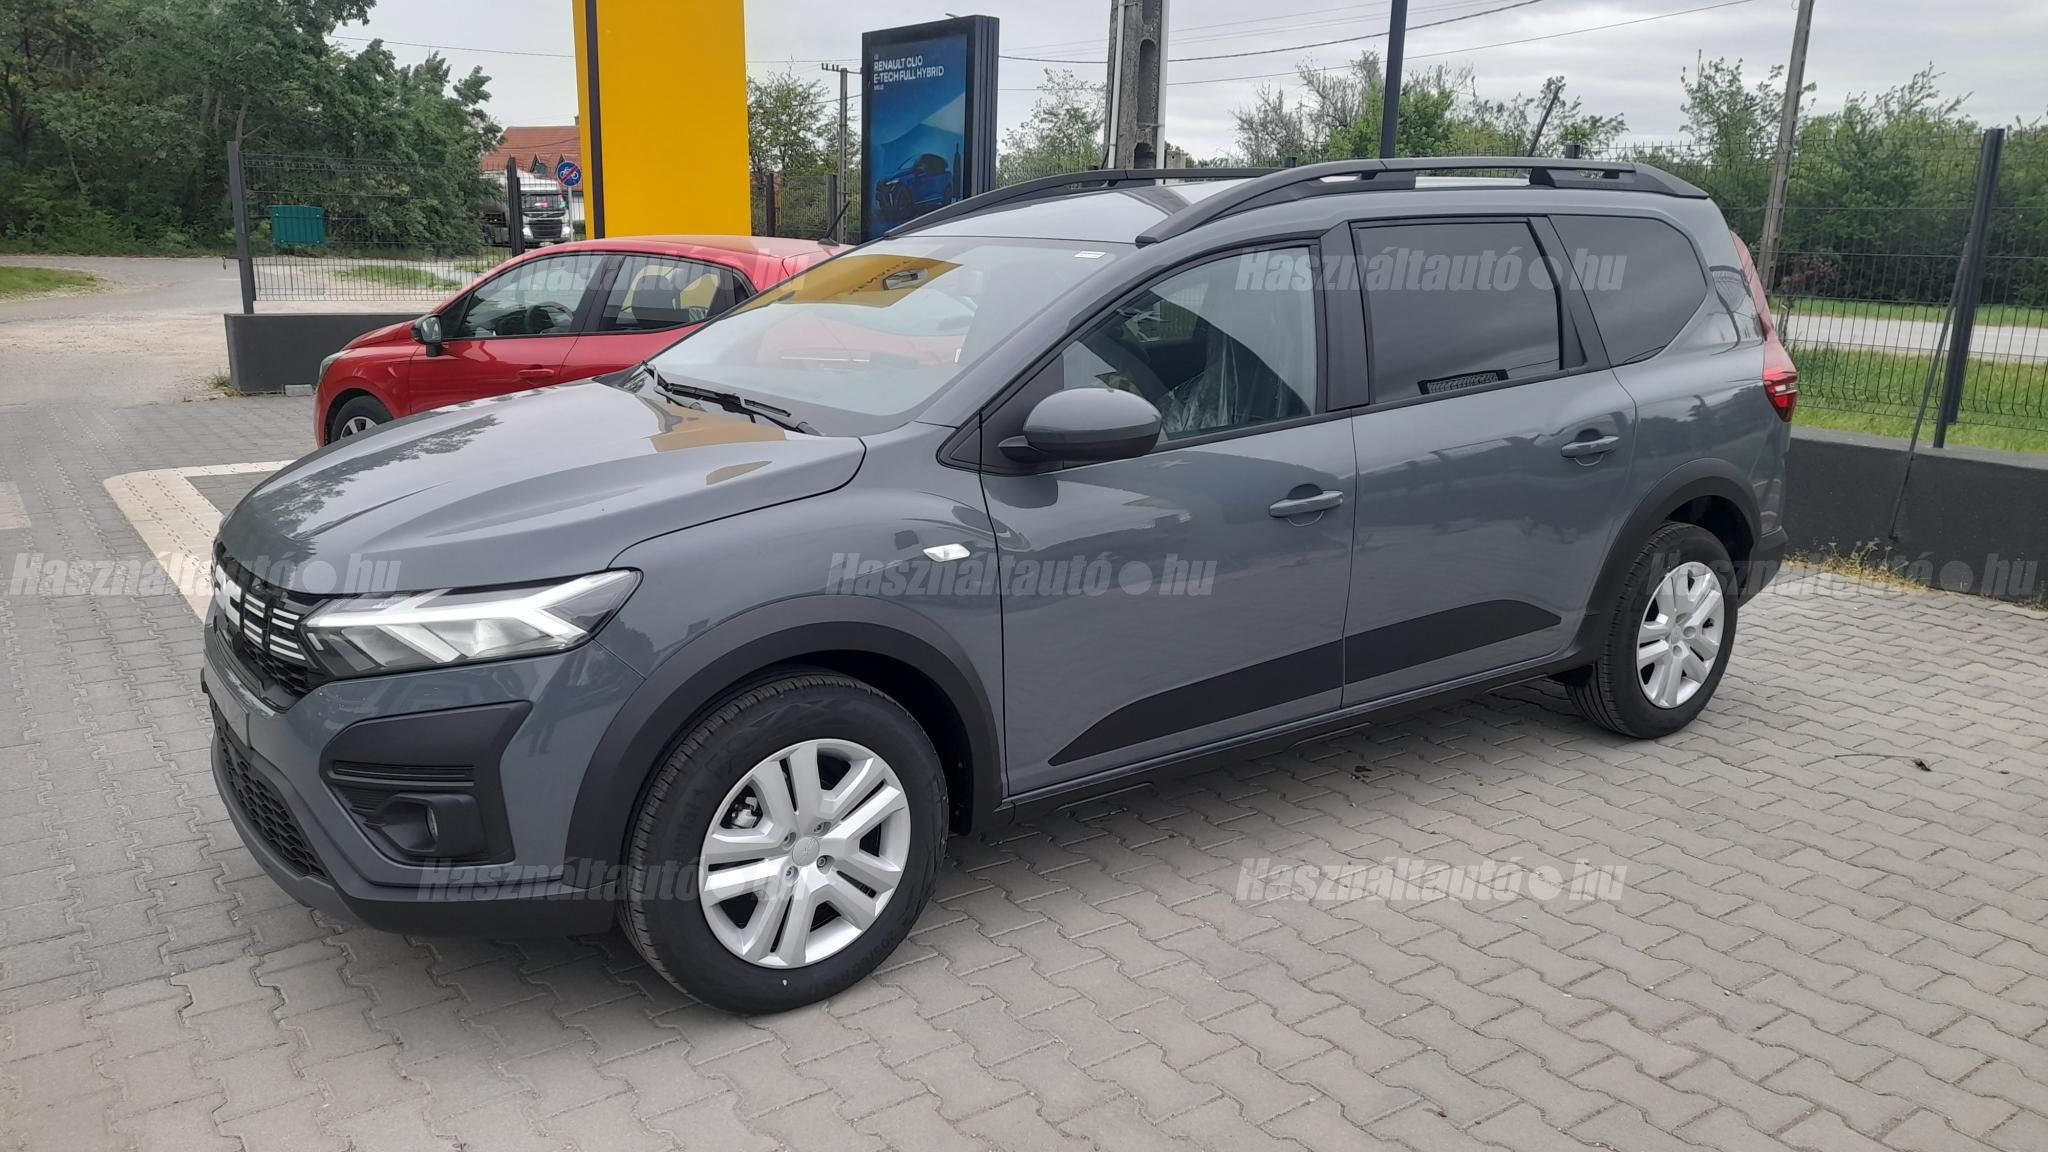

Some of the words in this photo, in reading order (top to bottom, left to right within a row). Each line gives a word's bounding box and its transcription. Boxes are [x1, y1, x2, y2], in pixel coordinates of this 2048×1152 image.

[873, 58, 905, 71] RENAULT
[906, 55, 922, 67] CLIO
[873, 72, 899, 83] E-TECH
[900, 70, 916, 80] FULL
[916, 66, 944, 78] HYBRID
